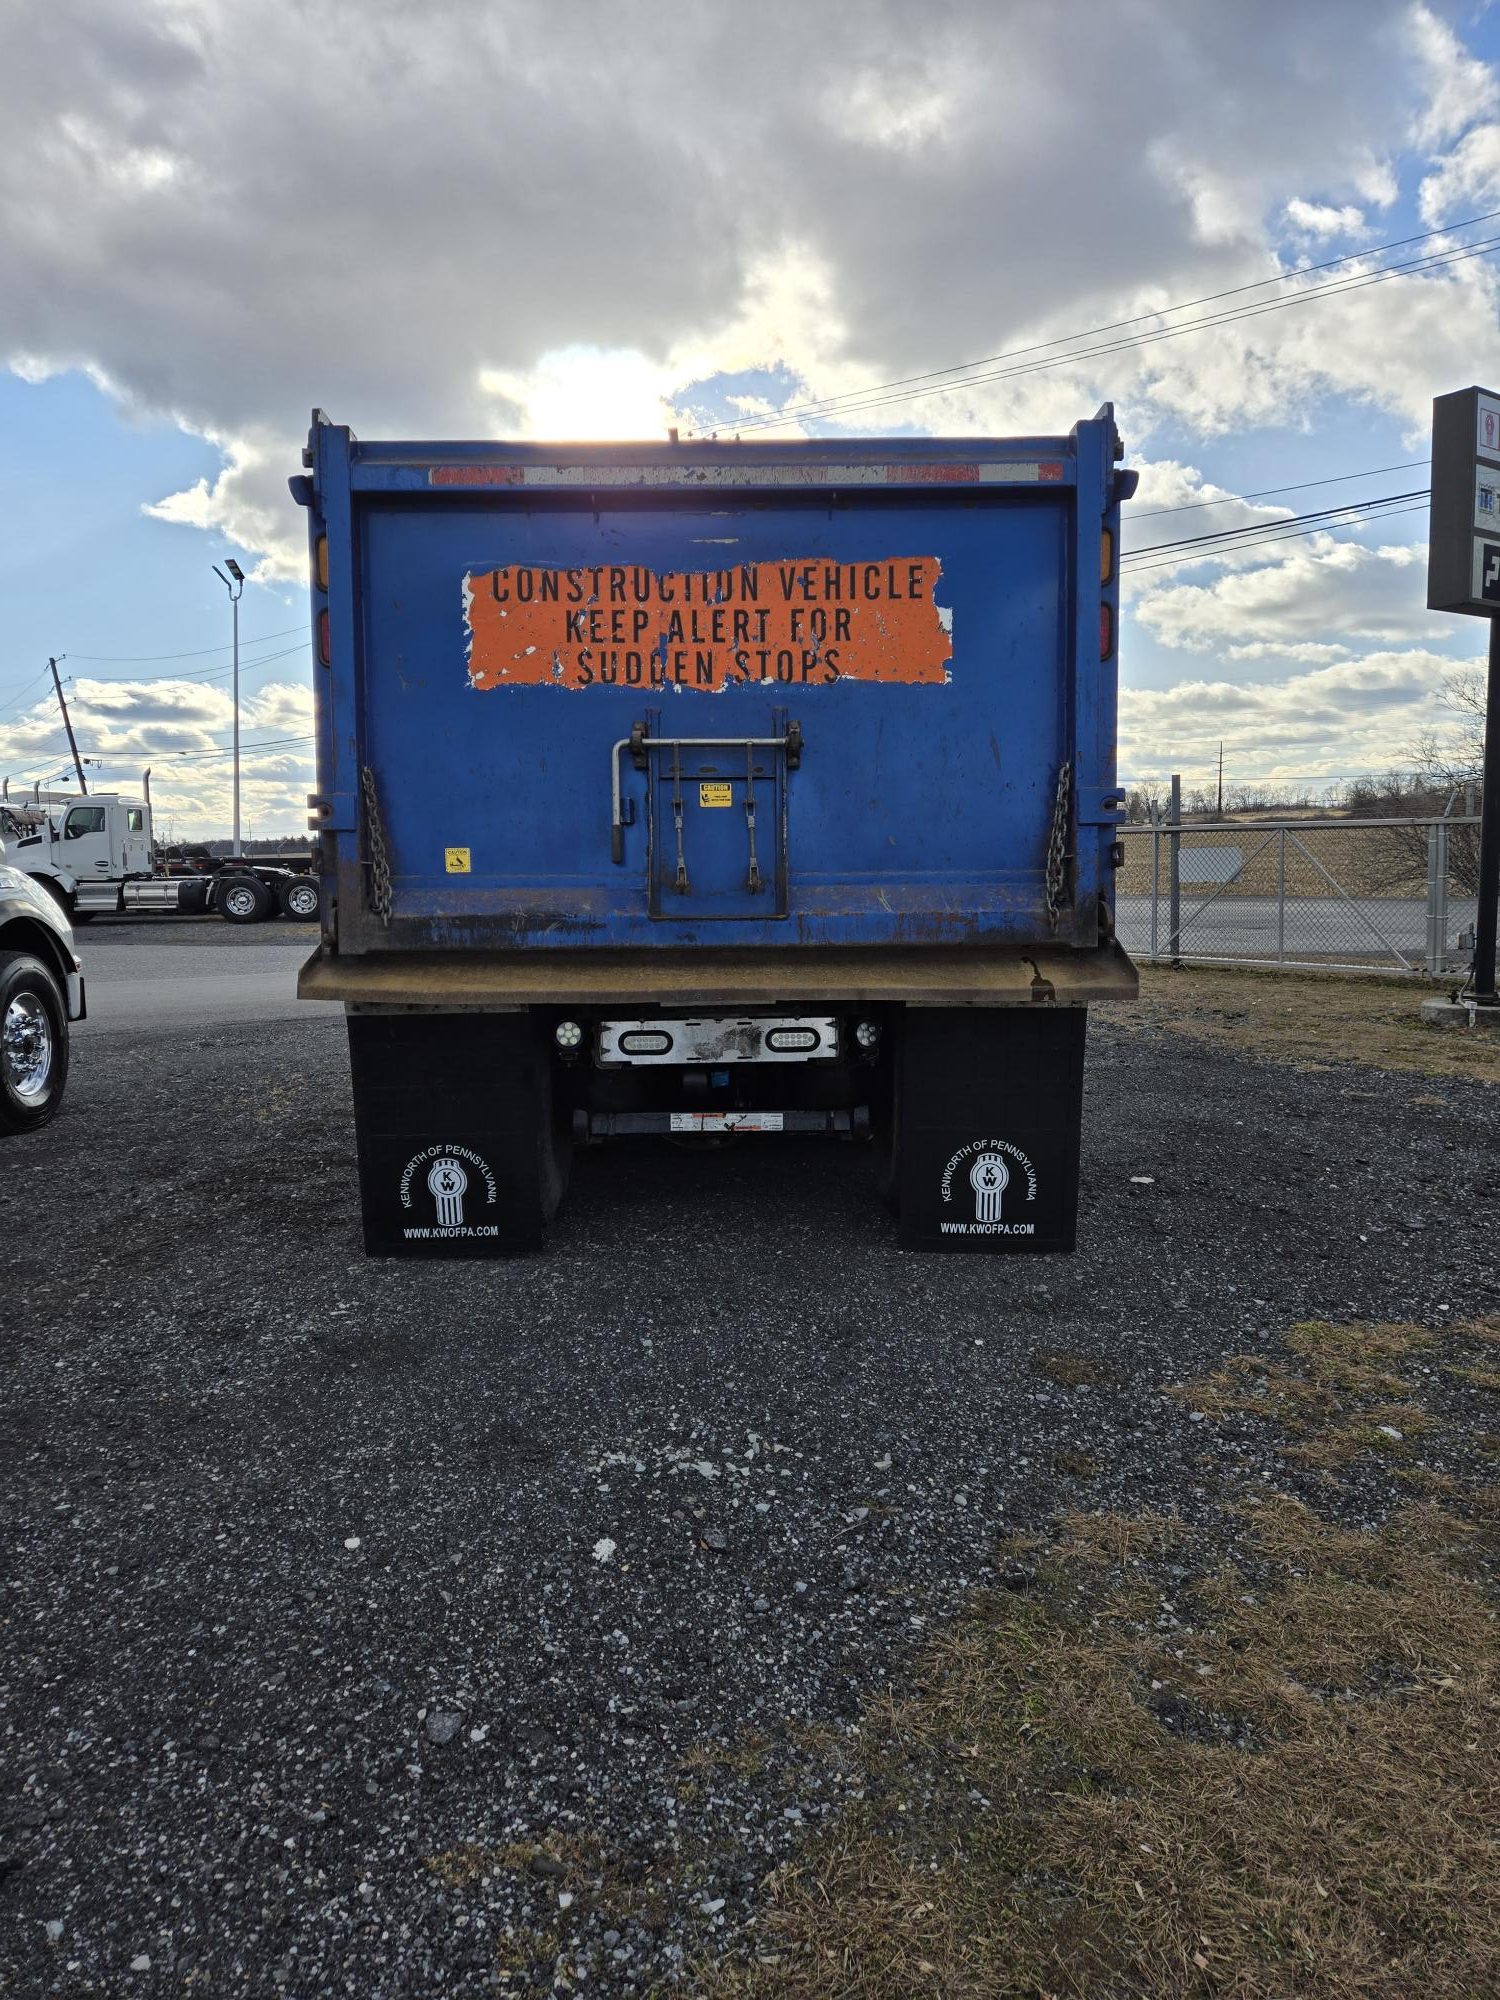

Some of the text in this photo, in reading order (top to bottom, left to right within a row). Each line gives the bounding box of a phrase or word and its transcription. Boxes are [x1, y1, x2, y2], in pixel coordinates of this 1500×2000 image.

[492, 564, 923, 602] CONSTRUCTION VEHICLE
[566, 607, 851, 643] KEEP ALERT FOR
[577, 649, 840, 685] SUDDEN STOPS
[400, 1144, 497, 1209] KENWORTH OF PENNSYLVANIA
[940, 1139, 1038, 1202] KENWORTH OF PENNSYLVANIA
[403, 1225, 499, 1239] WWW.KWOFPA.COM
[940, 1222, 1035, 1235] WWW.KWOFPA.COM
